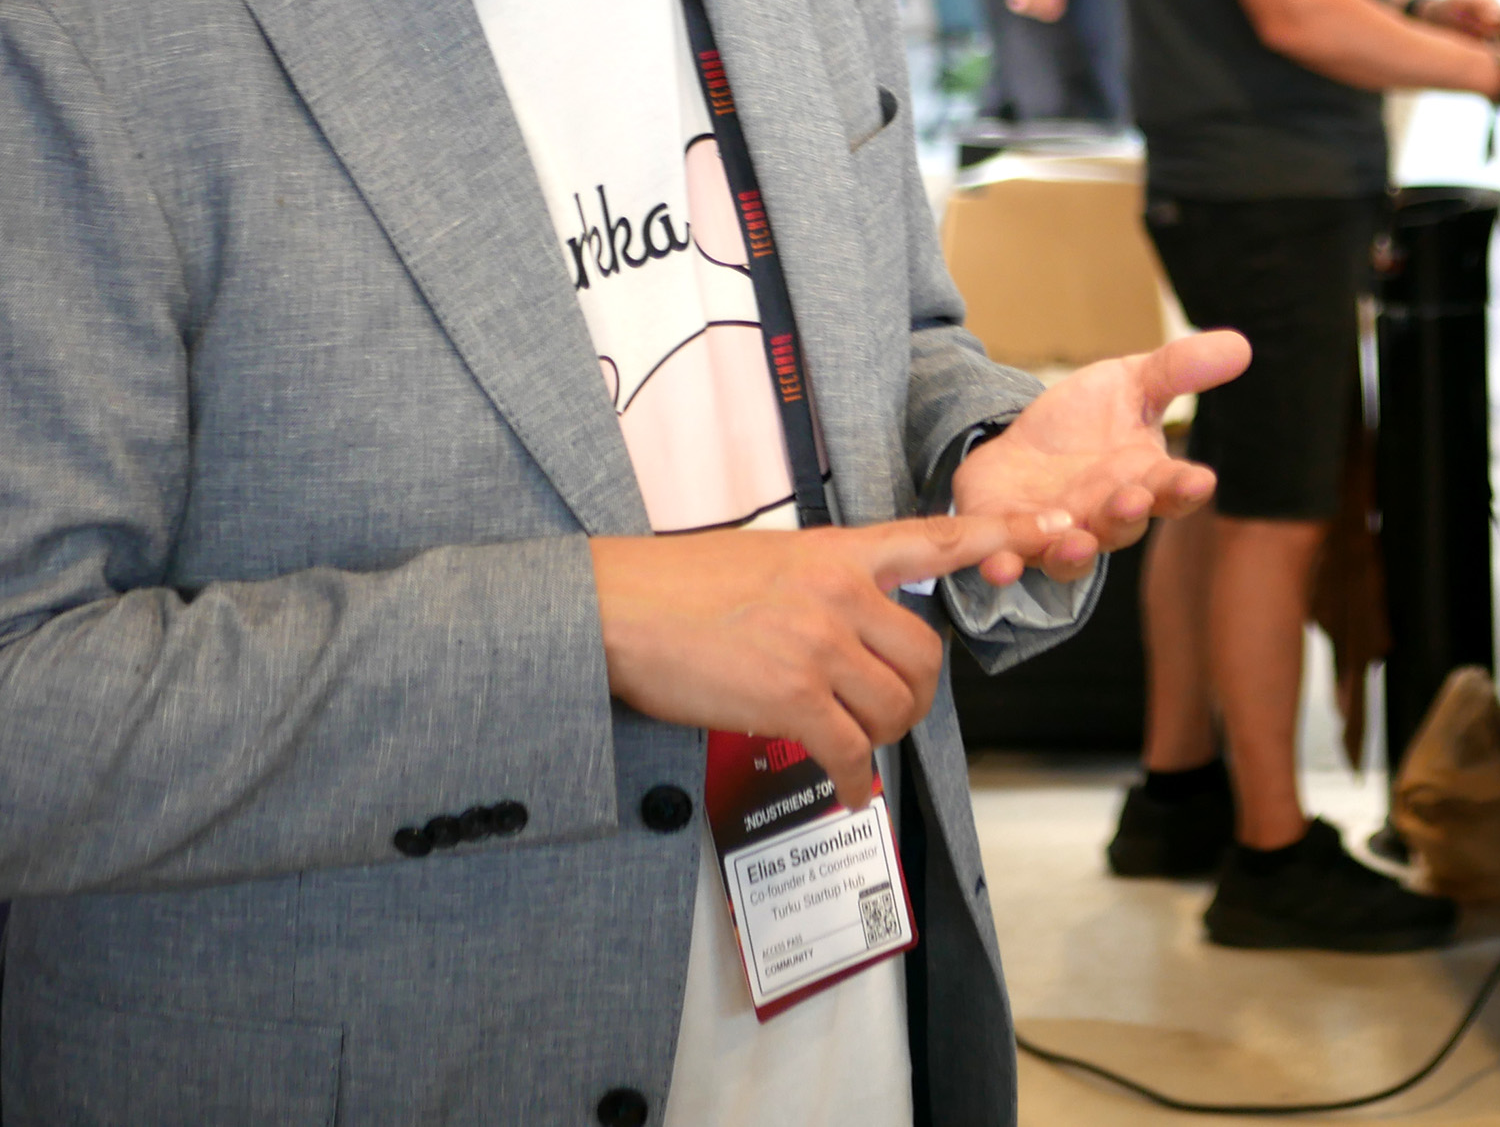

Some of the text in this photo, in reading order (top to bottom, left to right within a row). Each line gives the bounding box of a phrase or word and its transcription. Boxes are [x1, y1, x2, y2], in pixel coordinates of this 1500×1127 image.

[747, 819, 873, 885] Elias Savonlahti
[750, 846, 878, 906] Co-founder & Coordinator
[772, 900, 801, 921] Turku
[803, 884, 842, 908] Startup
[843, 874, 865, 892] Hub
[764, 947, 814, 977] COMMUNITY
